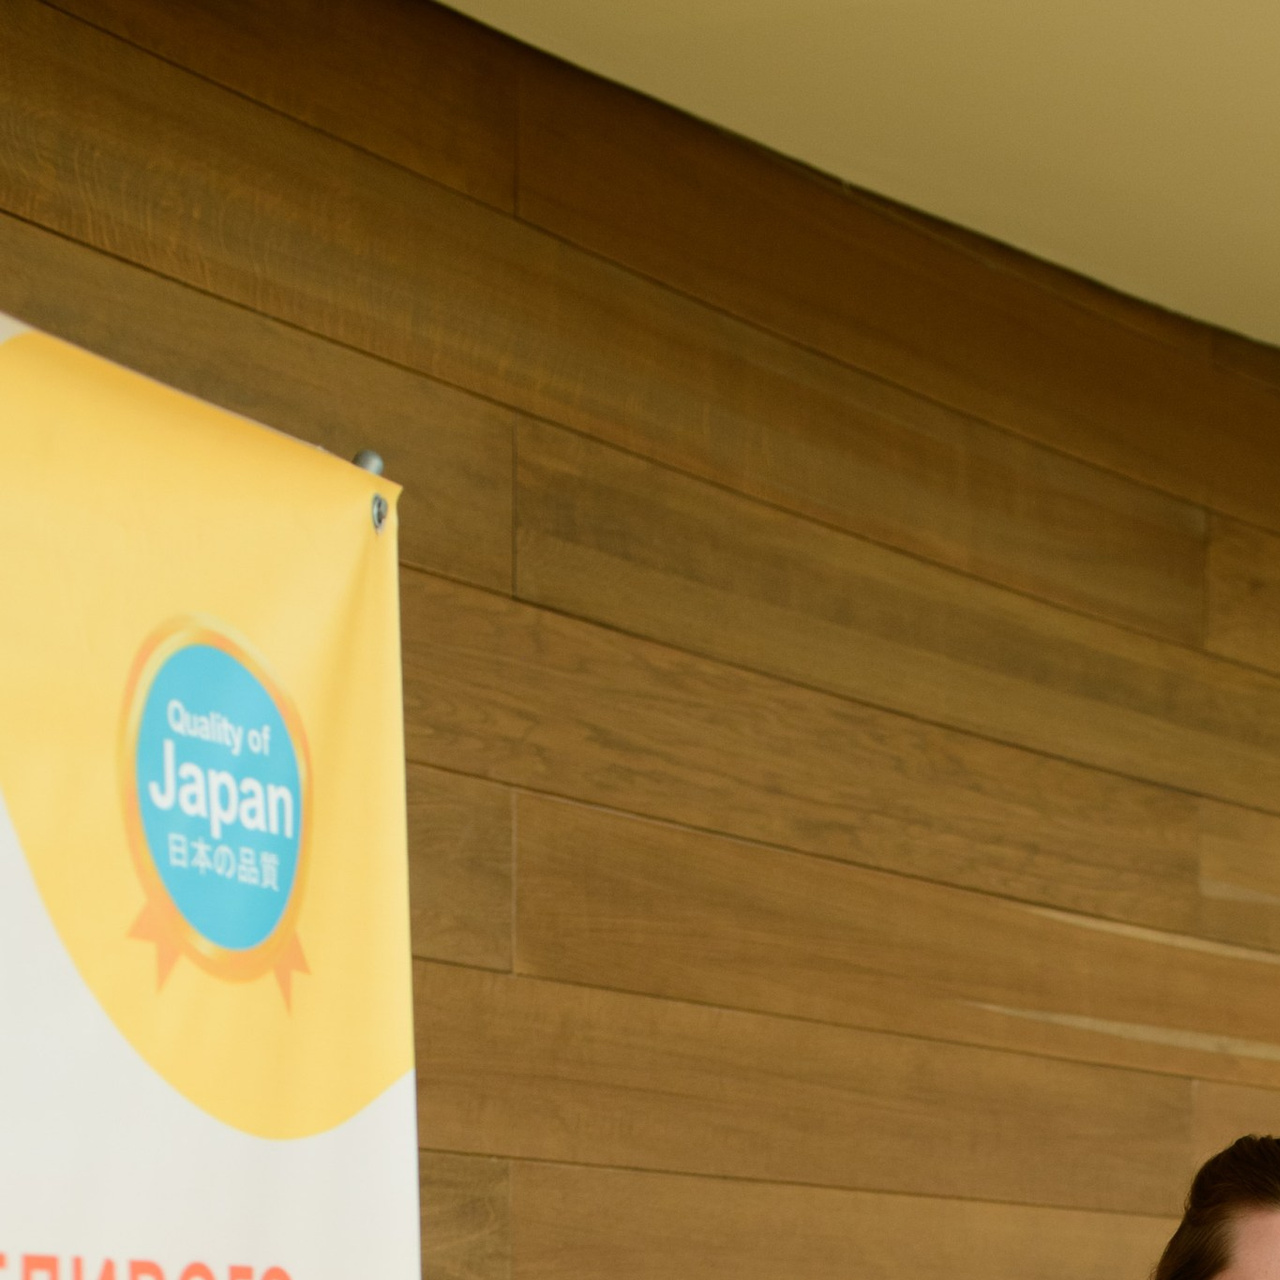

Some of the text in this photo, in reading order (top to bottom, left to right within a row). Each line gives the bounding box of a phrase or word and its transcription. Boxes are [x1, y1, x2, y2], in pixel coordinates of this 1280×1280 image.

[167, 699, 271, 756] Quality of
[148, 739, 294, 838] Japan
[168, 833, 281, 891] 日本の品質
